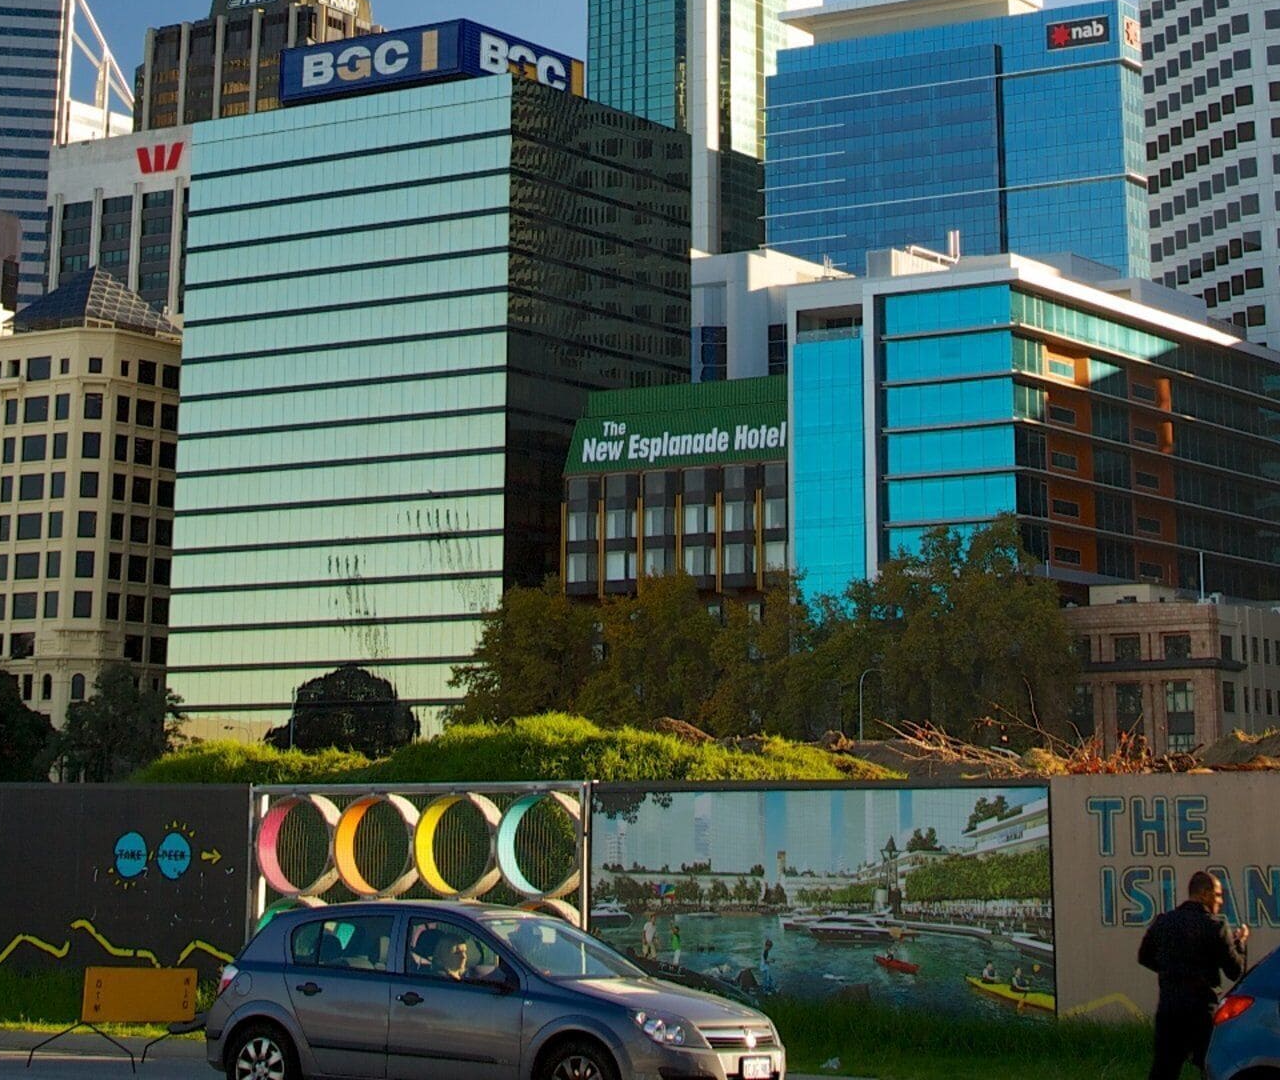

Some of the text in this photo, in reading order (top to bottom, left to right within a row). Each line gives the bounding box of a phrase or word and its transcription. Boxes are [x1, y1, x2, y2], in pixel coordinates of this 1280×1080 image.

[1071, 21, 1104, 39] nab
[302, 39, 410, 88] BGC
[480, 32, 566, 90] BGC
[582, 421, 787, 463] New Esplanade Hotel
[603, 421, 626, 436] The
[1086, 795, 1210, 857] THE
